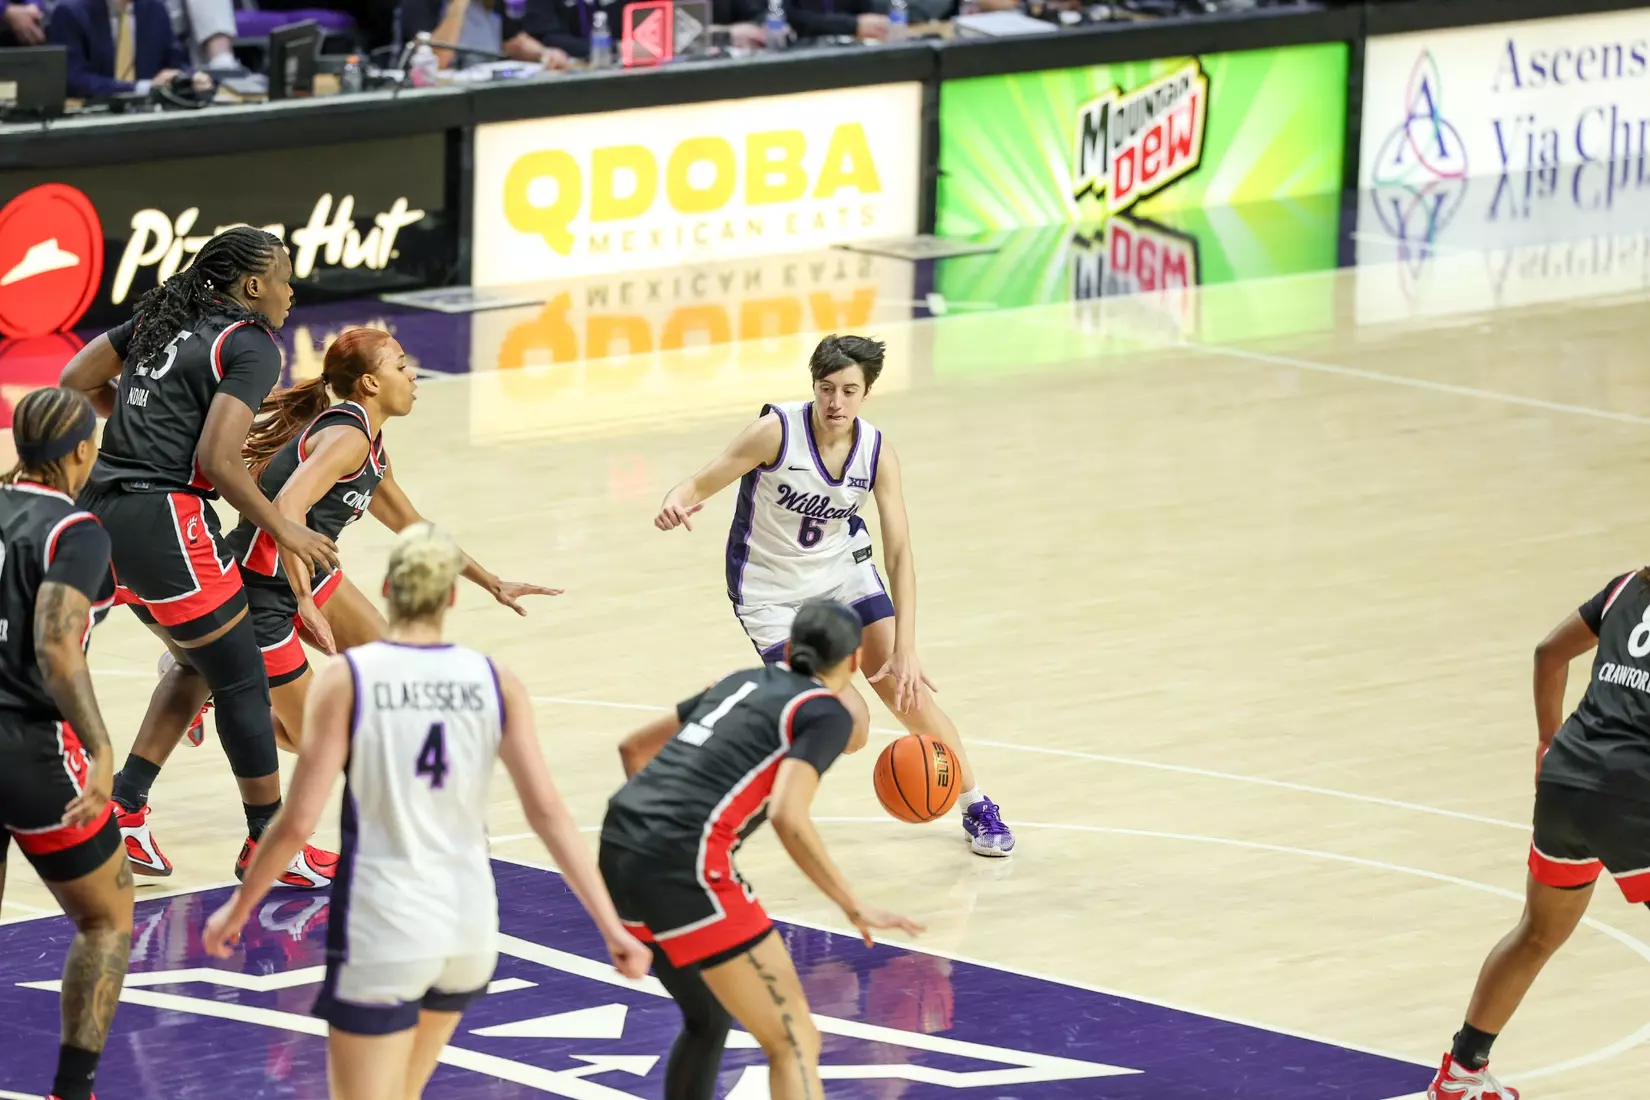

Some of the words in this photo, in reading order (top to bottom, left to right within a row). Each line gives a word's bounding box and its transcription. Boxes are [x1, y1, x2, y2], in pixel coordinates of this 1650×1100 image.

[1493, 114, 1559, 167] Via
[503, 122, 883, 256] QDOBA
[291, 192, 426, 279] Hut
[588, 217, 765, 254] MEXICAN
[785, 204, 876, 236] EATS
[776, 483, 860, 520] Wildcats
[796, 515, 828, 549] 6
[373, 681, 484, 712] CLAESSENS
[699, 680, 759, 729] 1
[415, 721, 449, 790] 4
